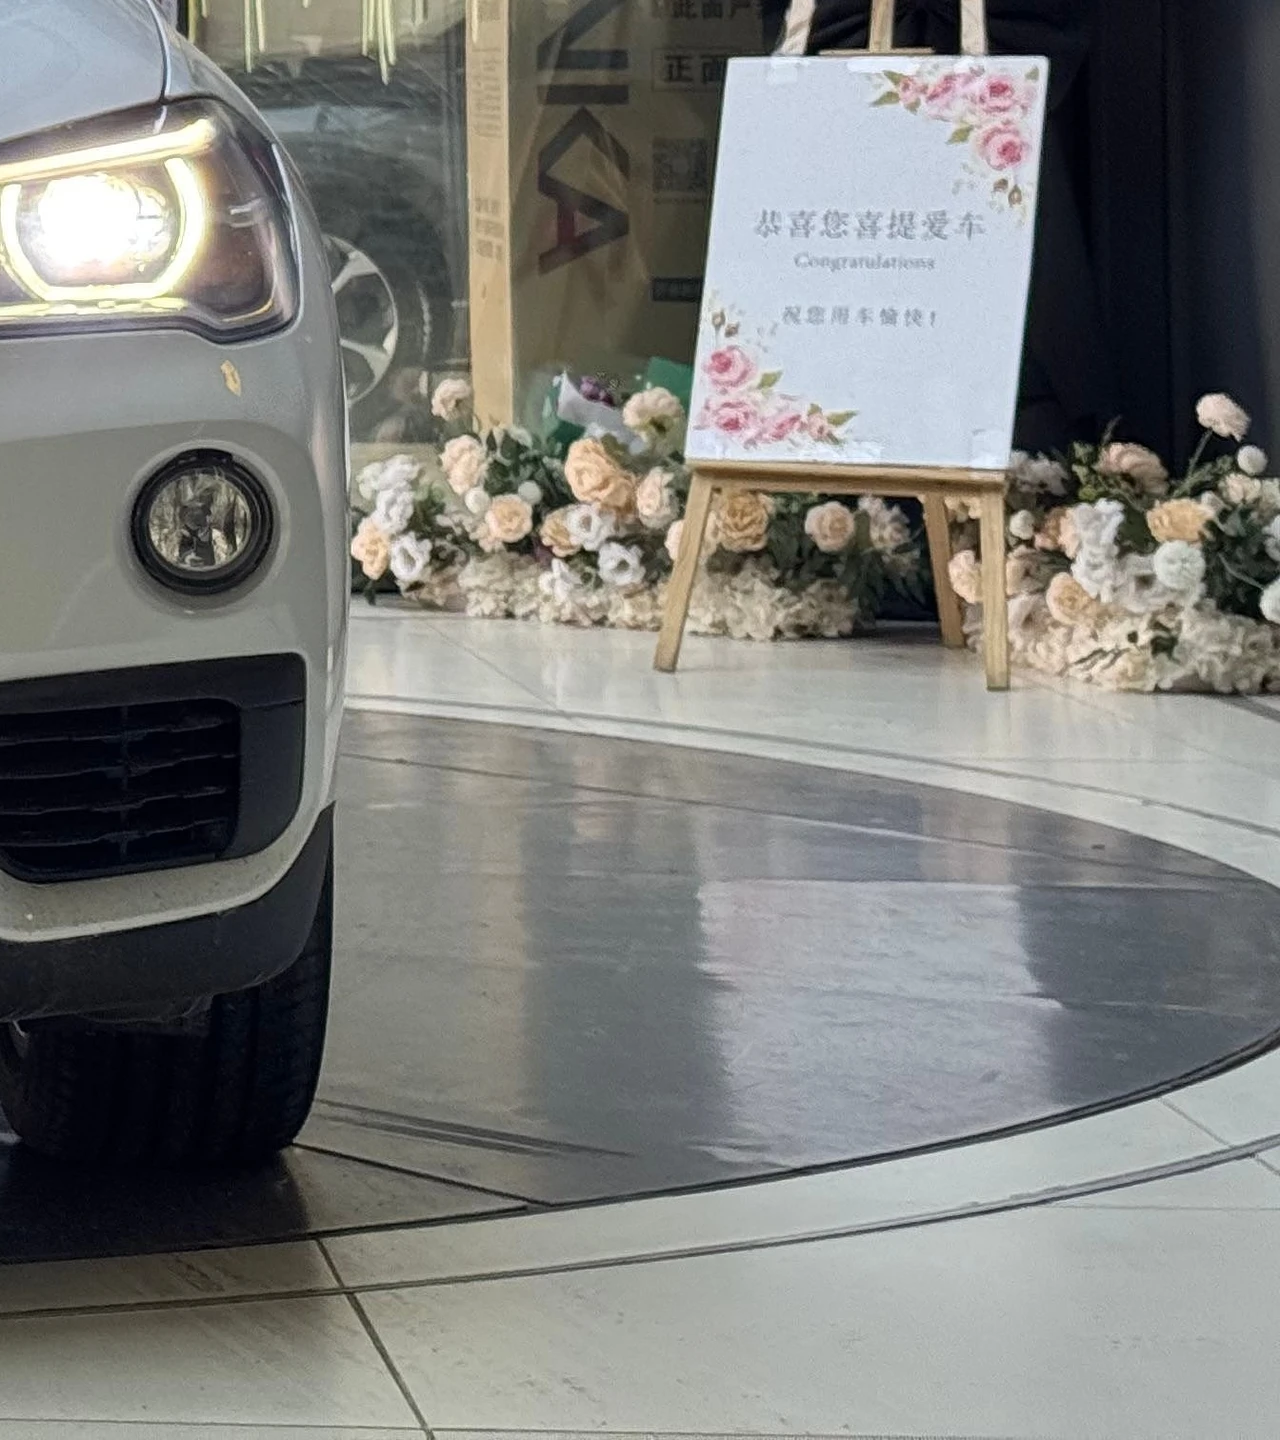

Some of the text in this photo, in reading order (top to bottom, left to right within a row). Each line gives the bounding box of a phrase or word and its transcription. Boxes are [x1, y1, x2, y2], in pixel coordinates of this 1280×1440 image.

[754, 208, 987, 242] 恭喜您喜提爱车
[793, 251, 937, 273] Congratulations
